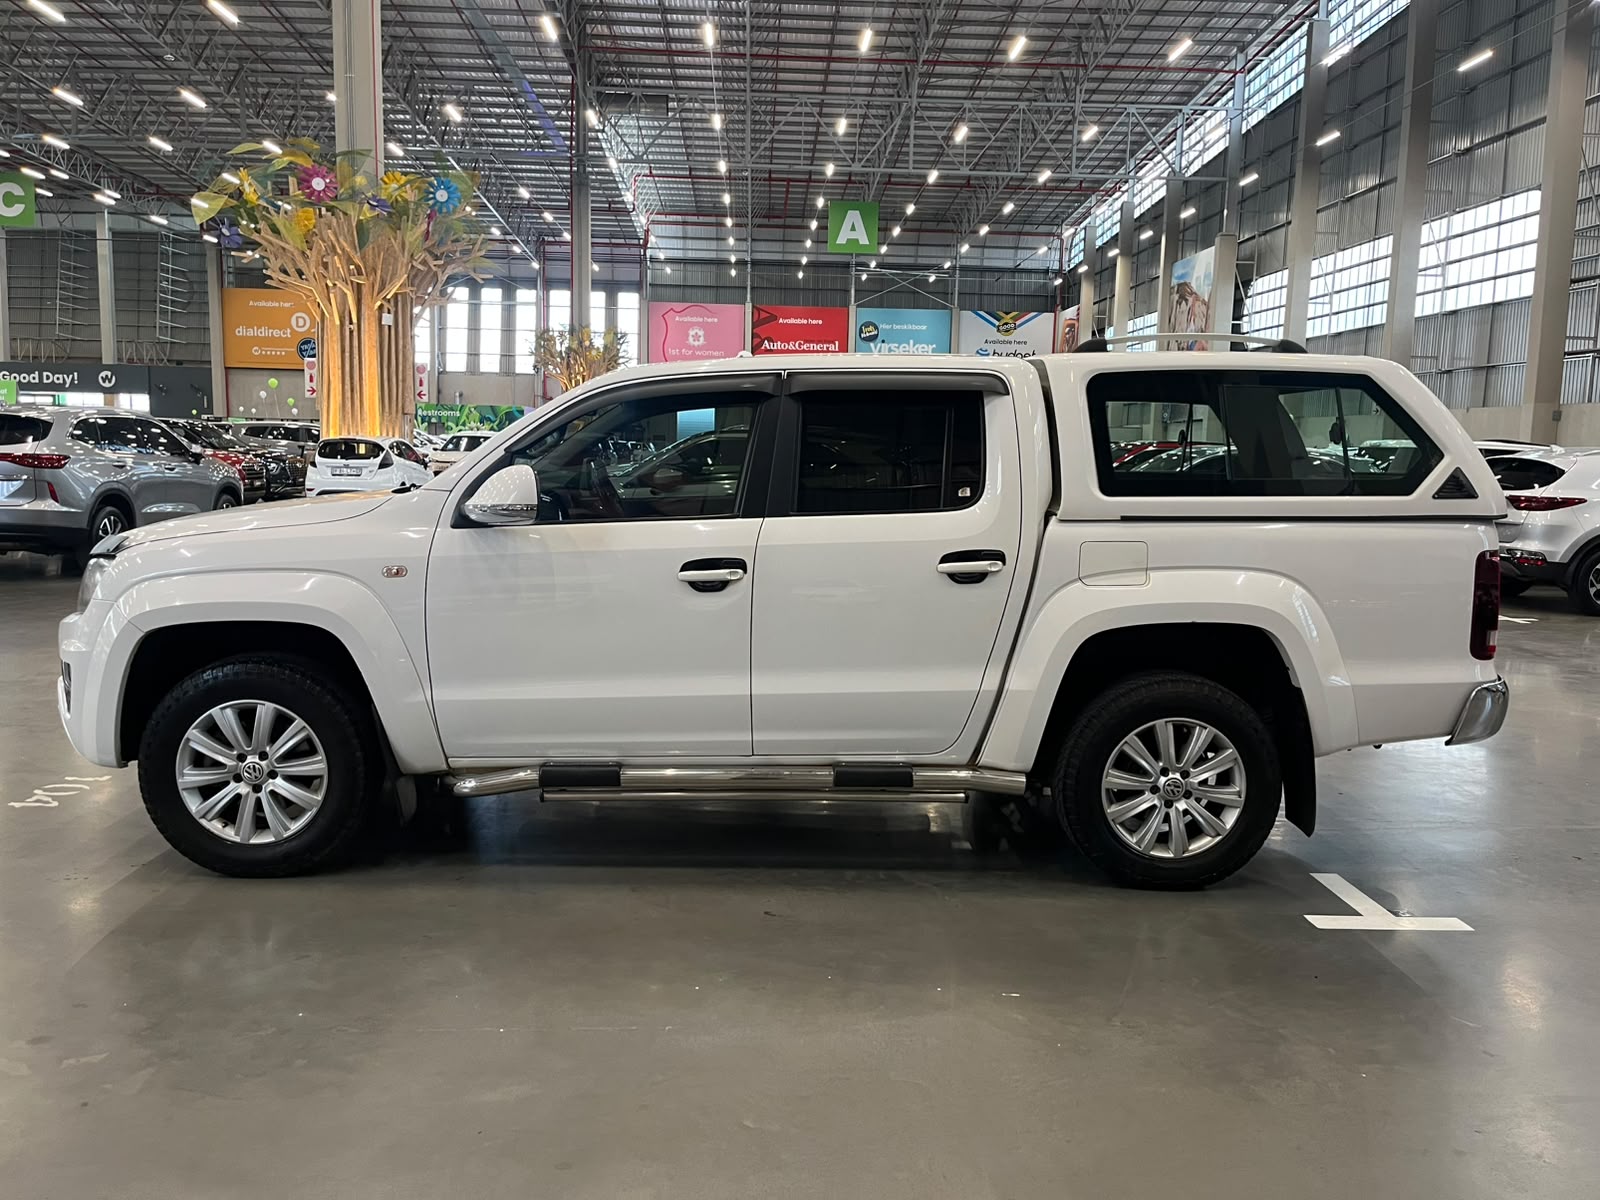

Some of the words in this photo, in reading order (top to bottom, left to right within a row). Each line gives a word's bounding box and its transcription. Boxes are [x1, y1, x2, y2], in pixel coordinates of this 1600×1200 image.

[0, 182, 25, 217] C
[836, 210, 870, 245] A
[249, 300, 279, 308] Available
[779, 317, 807, 325] Available
[235, 325, 291, 338] dialdirect
[761, 339, 839, 352] Auto&General
[870, 339, 936, 354] virseker
[668, 348, 680, 356] 1st
[682, 348, 693, 356] for
[695, 349, 725, 357] women
[0, 370, 39, 384] Good
[43, 371, 78, 388] Day!
[417, 408, 460, 418] Restrooms
